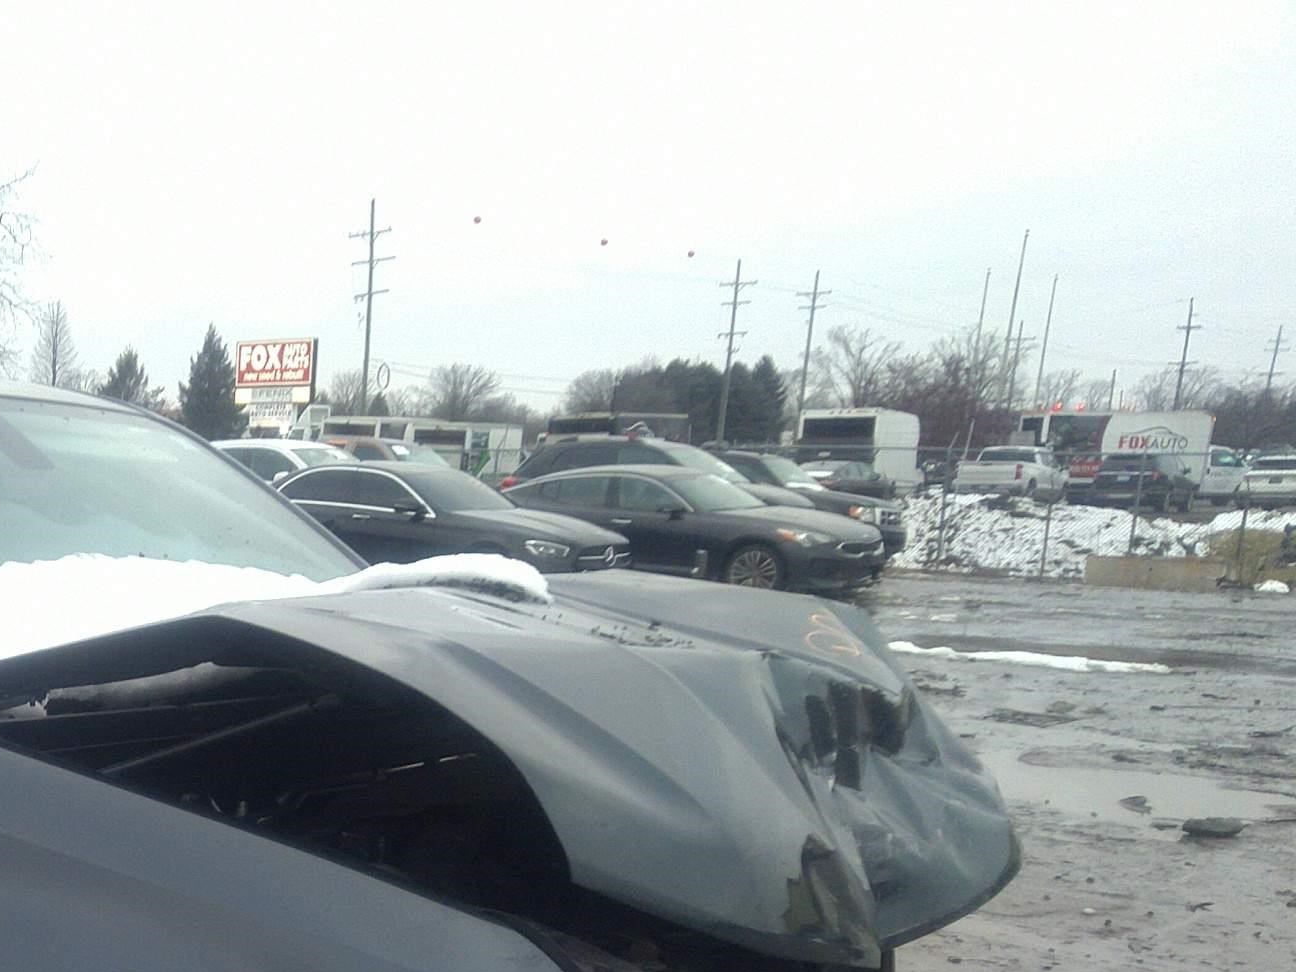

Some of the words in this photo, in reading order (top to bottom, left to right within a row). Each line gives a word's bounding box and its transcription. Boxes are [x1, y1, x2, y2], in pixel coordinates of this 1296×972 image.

[284, 343, 308, 355] AUTO
[240, 344, 282, 370] FOX
[283, 355, 309, 369] PARTS
